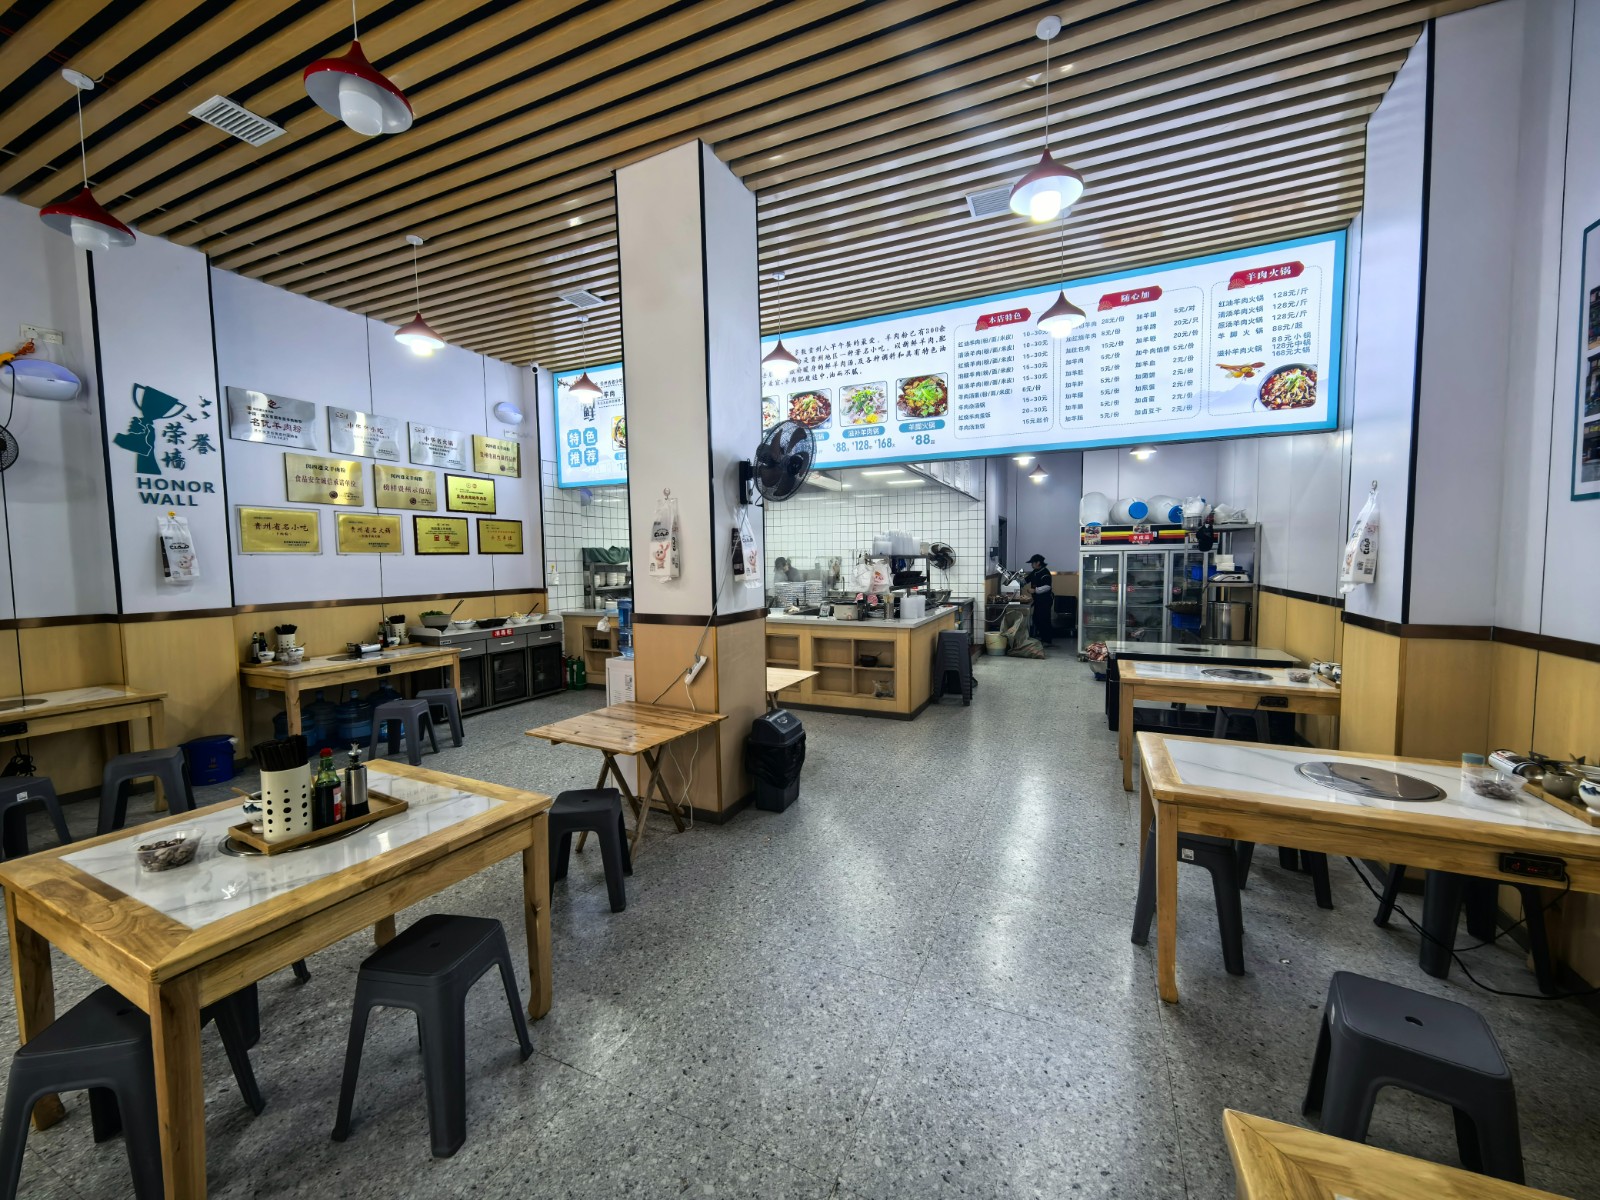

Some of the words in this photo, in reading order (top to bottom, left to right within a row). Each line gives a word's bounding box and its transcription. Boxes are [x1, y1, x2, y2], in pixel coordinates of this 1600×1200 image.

[1246, 265, 1292, 282] 羊肉火锅
[1121, 290, 1150, 303] 随心加
[1272, 286, 1309, 299] 128元/斤
[1218, 294, 1265, 308] 红油羊肉火锅
[1272, 298, 1308, 310] 128元/斤
[989, 311, 1022, 325] 本店特色
[1218, 305, 1264, 319] 清汤羊肉火锅
[1271, 309, 1308, 321] 128元/斤
[1173, 316, 1199, 326] 20元/只
[1272, 321, 1303, 332] 88元/起
[1173, 329, 1199, 339] 20元/份
[1271, 339, 1311, 350] 128元中锅
[1271, 346, 1311, 357] 168元大锅
[1172, 355, 1194, 363] 2元/份
[1172, 367, 1194, 376] 2元/份
[1172, 379, 1194, 388] 2元/份
[1171, 391, 1193, 400] 2元/份
[1171, 404, 1193, 412] 2元/份
[569, 431, 596, 445] 特色
[570, 451, 597, 465] 推荐
[137, 476, 215, 494] HONOR
[139, 491, 199, 507] WALL
[254, 521, 309, 532] 贵州省名小吃
